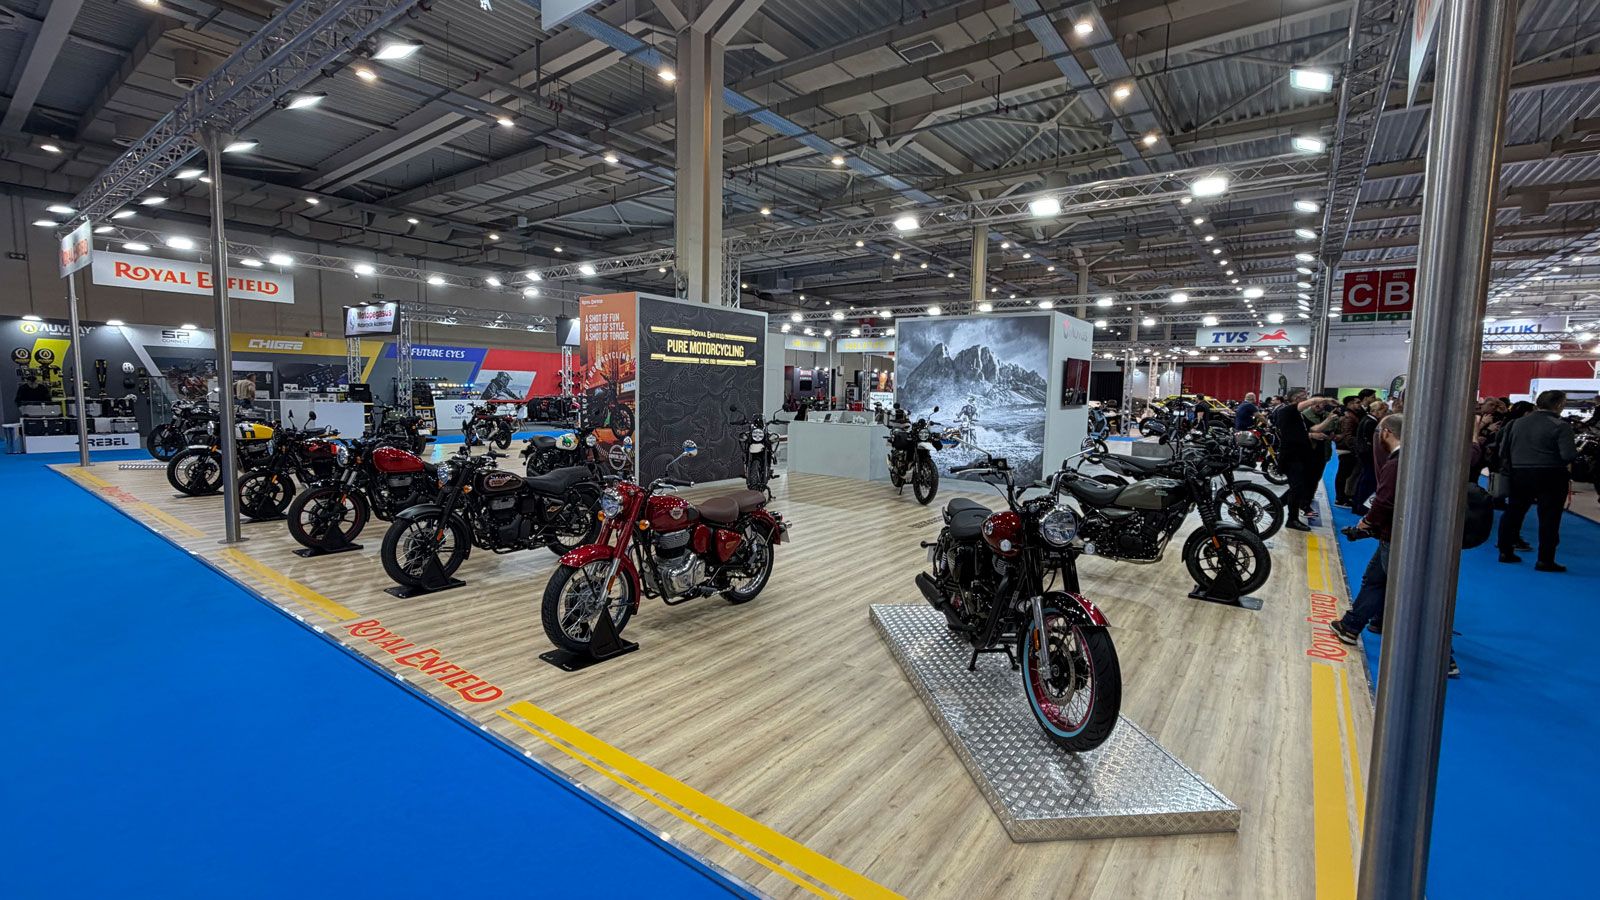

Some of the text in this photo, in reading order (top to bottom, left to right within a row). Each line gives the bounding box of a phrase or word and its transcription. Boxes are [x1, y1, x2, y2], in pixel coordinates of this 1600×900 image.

[114, 261, 279, 295] ROYAL EFIELD
[1348, 283, 1373, 307] C
[1384, 281, 1409, 305] B
[585, 312, 620, 323] A SHOT OF FUN
[585, 321, 625, 333] A SHOT OF STYLE
[1484, 324, 1542, 335] UZUKI
[161, 330, 190, 339] SP
[585, 331, 629, 341] A SHOT OF TORQUE
[691, 329, 725, 340] ROYAL ENFIELD
[1212, 331, 1250, 344] TVS
[248, 339, 303, 350] CHIGEE
[667, 339, 744, 358] PURE MOTORCYCLING
[411, 348, 465, 359] FUTURE EYES
[85, 437, 129, 447] REBEL
[1307, 626, 1347, 662] ROYAL
[344, 619, 503, 703] ROYAL ENFIELD
